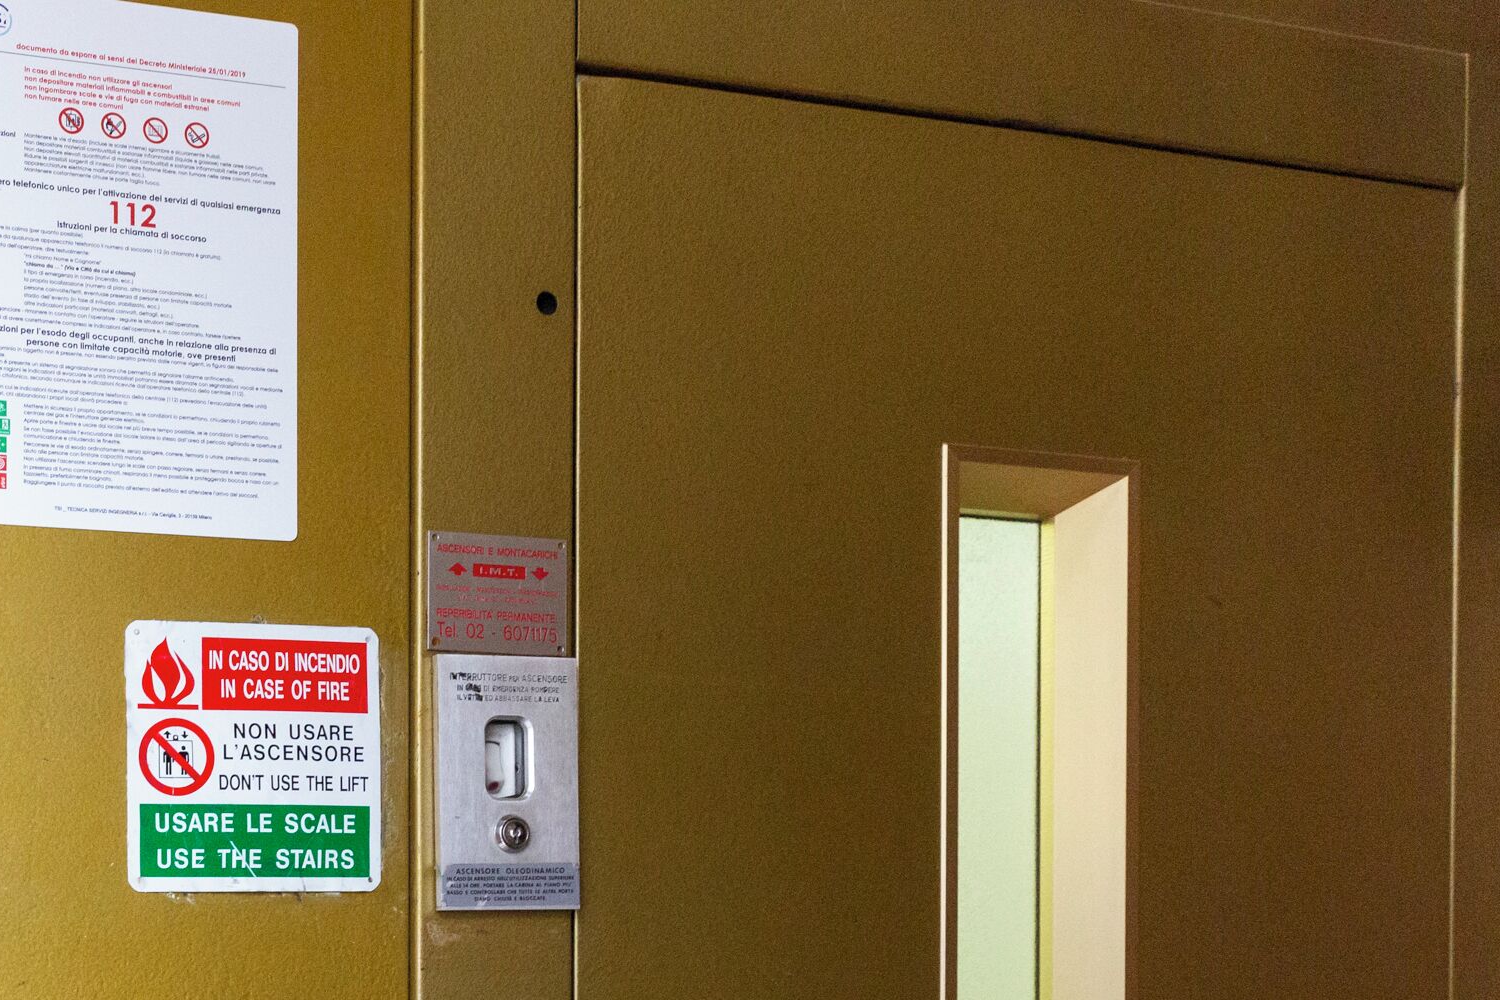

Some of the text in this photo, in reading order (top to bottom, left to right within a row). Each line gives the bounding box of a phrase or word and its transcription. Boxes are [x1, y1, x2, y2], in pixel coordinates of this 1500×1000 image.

[13, 180, 55, 191] telefonico
[57, 185, 80, 194] unico
[82, 188, 96, 196] per
[98, 189, 147, 201] l'attivazione
[149, 194, 163, 202] dei
[164, 197, 189, 205] servizi
[190, 198, 198, 206] di
[200, 201, 234, 210] qualsiasi
[236, 205, 281, 215] emergenza
[110, 201, 156, 228] 112
[109, 226, 118, 234] la
[119, 228, 159, 238] chiamata
[161, 231, 169, 239] di
[171, 234, 207, 243] soccorso
[26, 339, 60, 348] persone
[80, 342, 111, 352] limitate
[112, 347, 150, 355] capacità
[152, 350, 185, 358] motorie,
[204, 354, 236, 362] presenti
[36, 328, 67, 337] l'esodo
[69, 331, 90, 341] degli
[92, 334, 136, 343] occupanti,
[138, 338, 165, 346] anche
[166, 339, 174, 347] in
[175, 340, 213, 350] relazione
[214, 343, 229, 351] alla
[231, 346, 267, 355] presenza
[437, 544, 558, 560] ASCENSORI E MONTACARICHI
[479, 566, 519, 577] I.M.T.
[497, 611, 556, 624] PERMANENTE
[466, 623, 485, 640] 02
[503, 625, 558, 643] 6071175
[209, 650, 360, 673] IN CASO DI INCENDIO
[522, 675, 568, 684] ASCENSORE
[221, 679, 350, 701] IN CASE OF FIRE
[234, 723, 353, 741] NON USARE
[223, 744, 364, 762] L'ASCENSORE
[219, 774, 369, 792] DON'T USE THE LIFT
[155, 813, 356, 834] USARE LE SCALE
[157, 847, 355, 870] USE THE STAIRS
[505, 867, 566, 875] OLEODINAMICO
